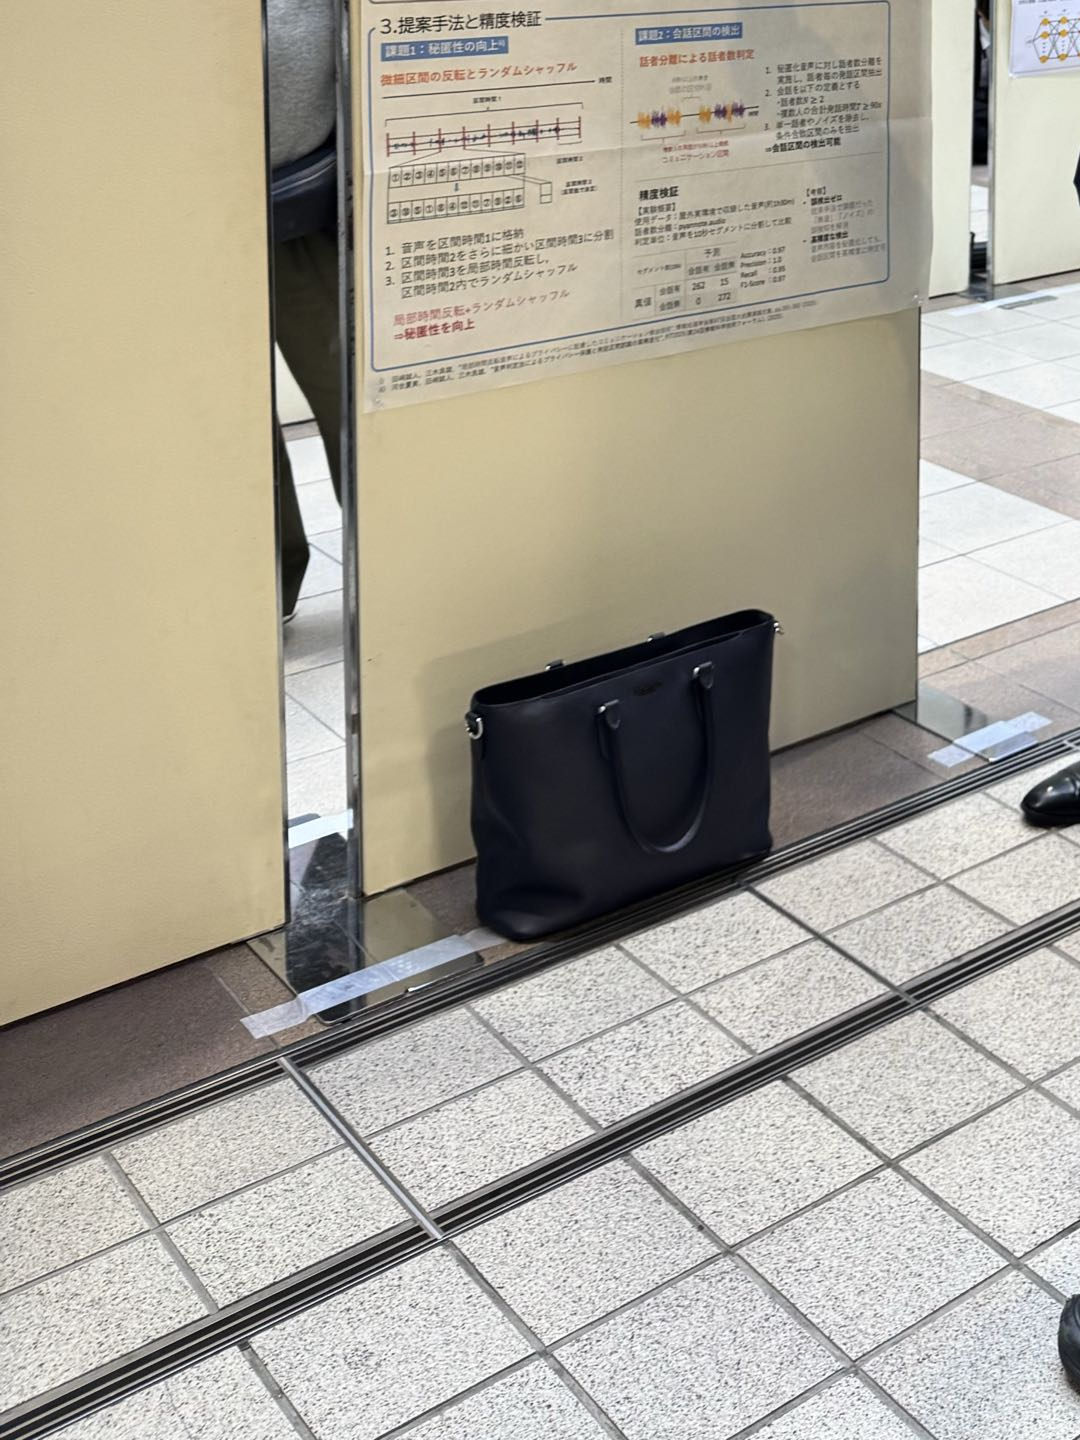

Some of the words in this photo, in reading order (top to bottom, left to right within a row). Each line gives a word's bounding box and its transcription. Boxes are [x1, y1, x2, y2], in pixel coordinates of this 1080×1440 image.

[380, 11, 541, 34] 3.提案手法と精度検証
